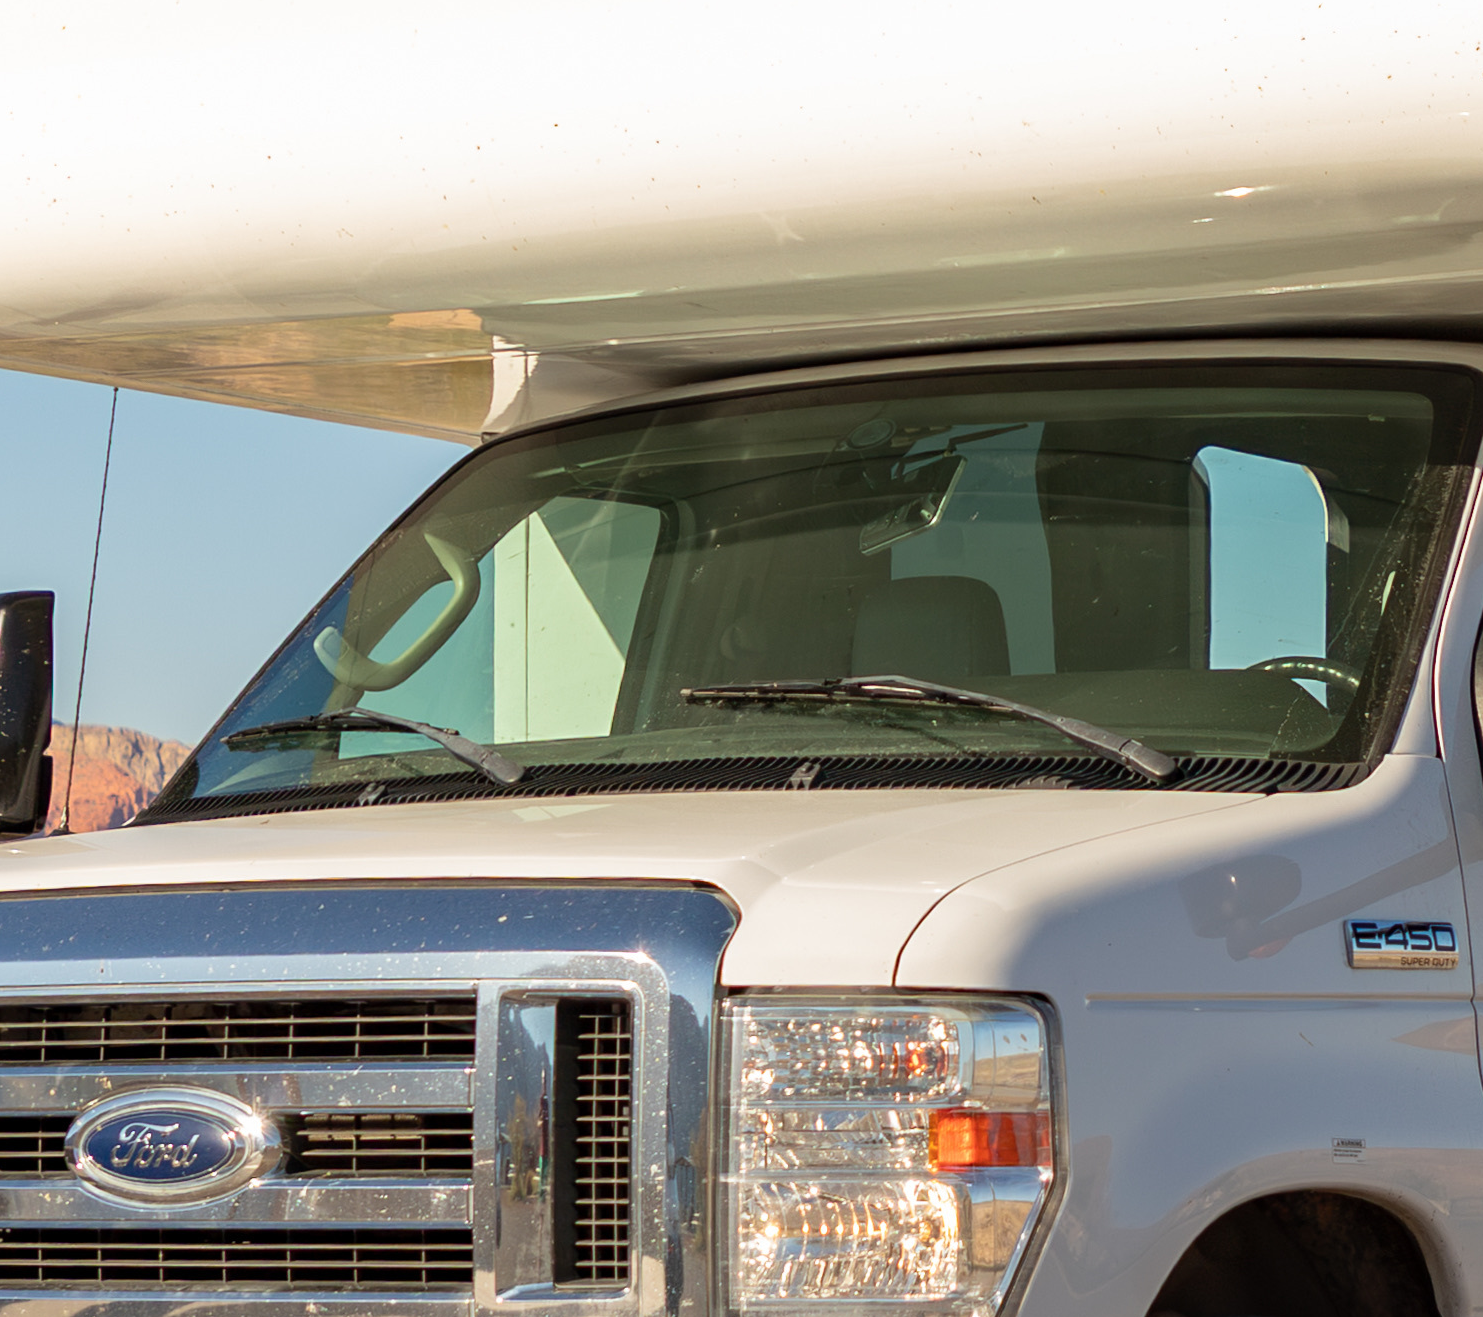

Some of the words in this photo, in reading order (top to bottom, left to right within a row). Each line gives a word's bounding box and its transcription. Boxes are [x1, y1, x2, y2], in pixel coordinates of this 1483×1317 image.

[1351, 922, 1457, 952] E-450
[1400, 956, 1430, 967] SUPER
[1432, 957, 1457, 967] DUTY
[110, 1122, 200, 1169] Ford
